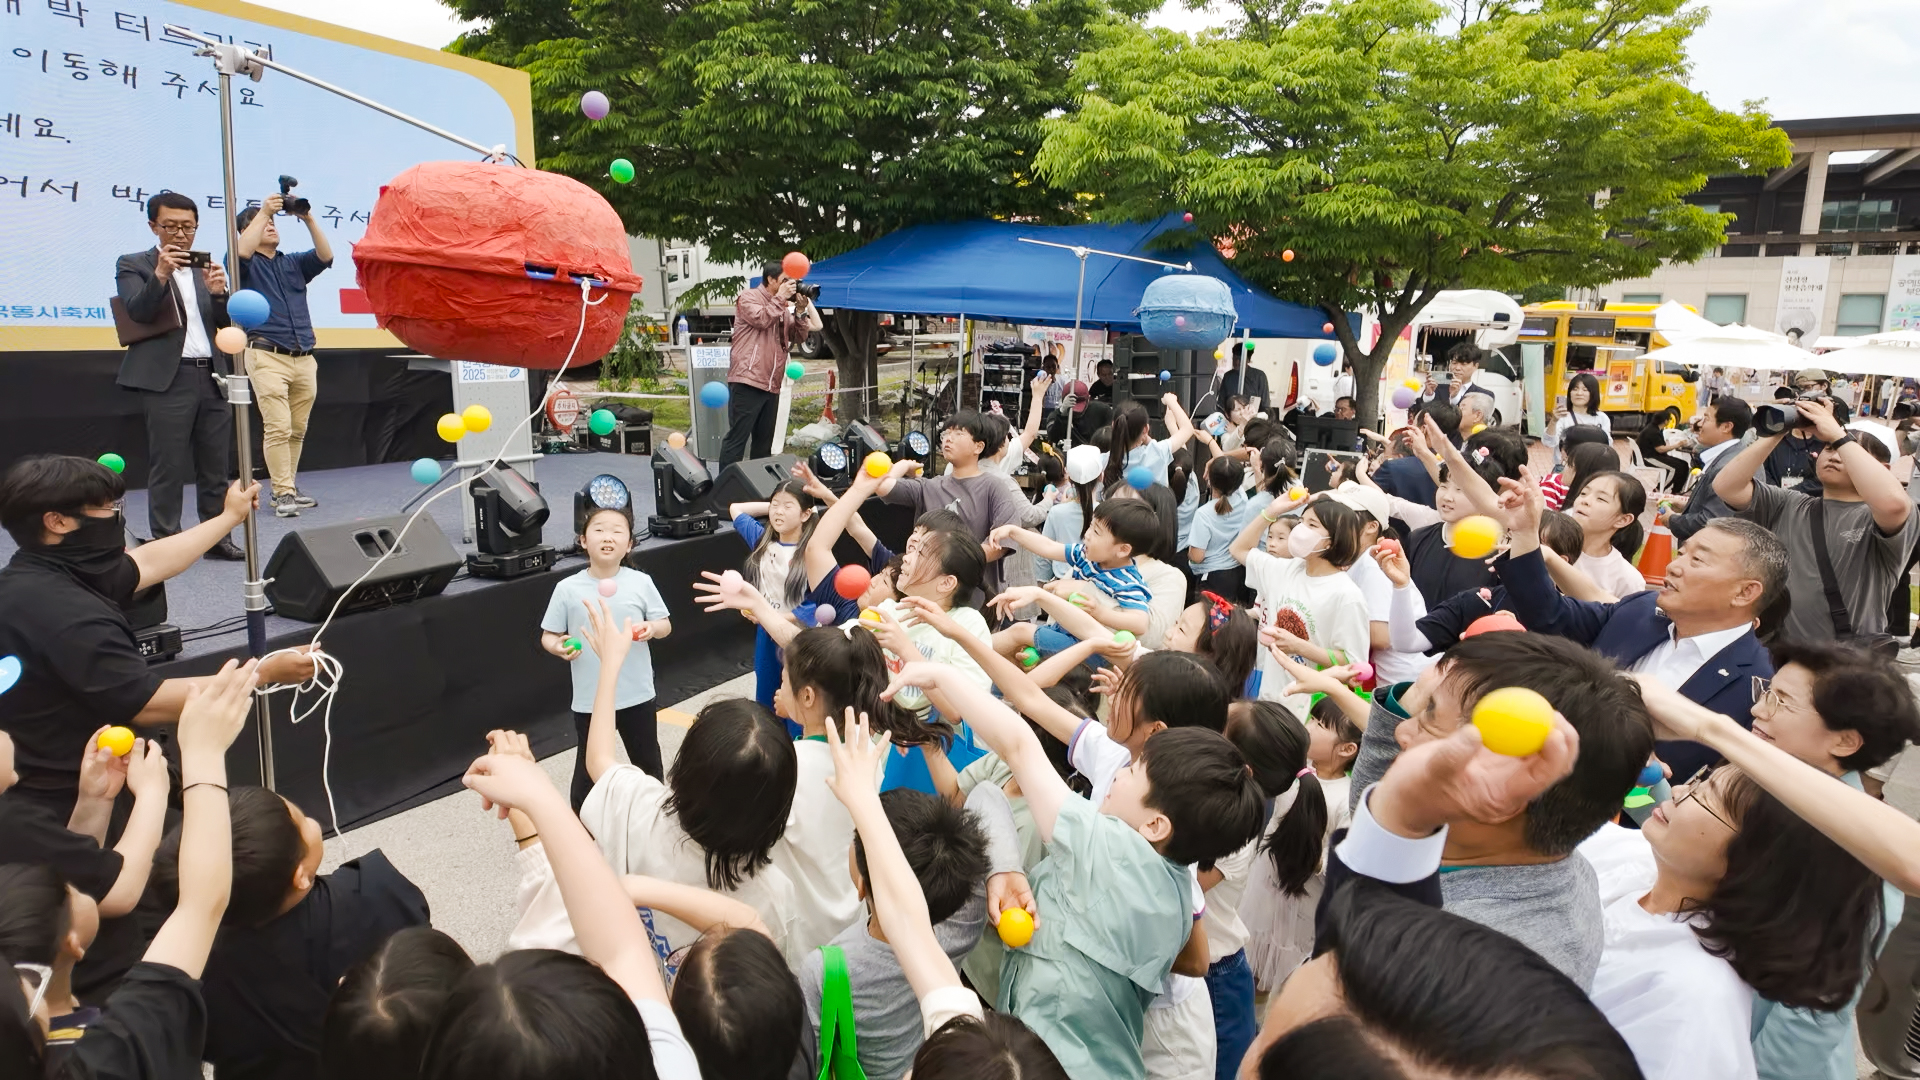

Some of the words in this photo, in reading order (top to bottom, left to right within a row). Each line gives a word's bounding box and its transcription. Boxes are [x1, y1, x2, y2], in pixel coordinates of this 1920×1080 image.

[48, 0, 89, 28] 박
[12, 47, 138, 89] 이동해
[696, 357, 718, 367] 2025
[462, 368, 486, 381] 2025
